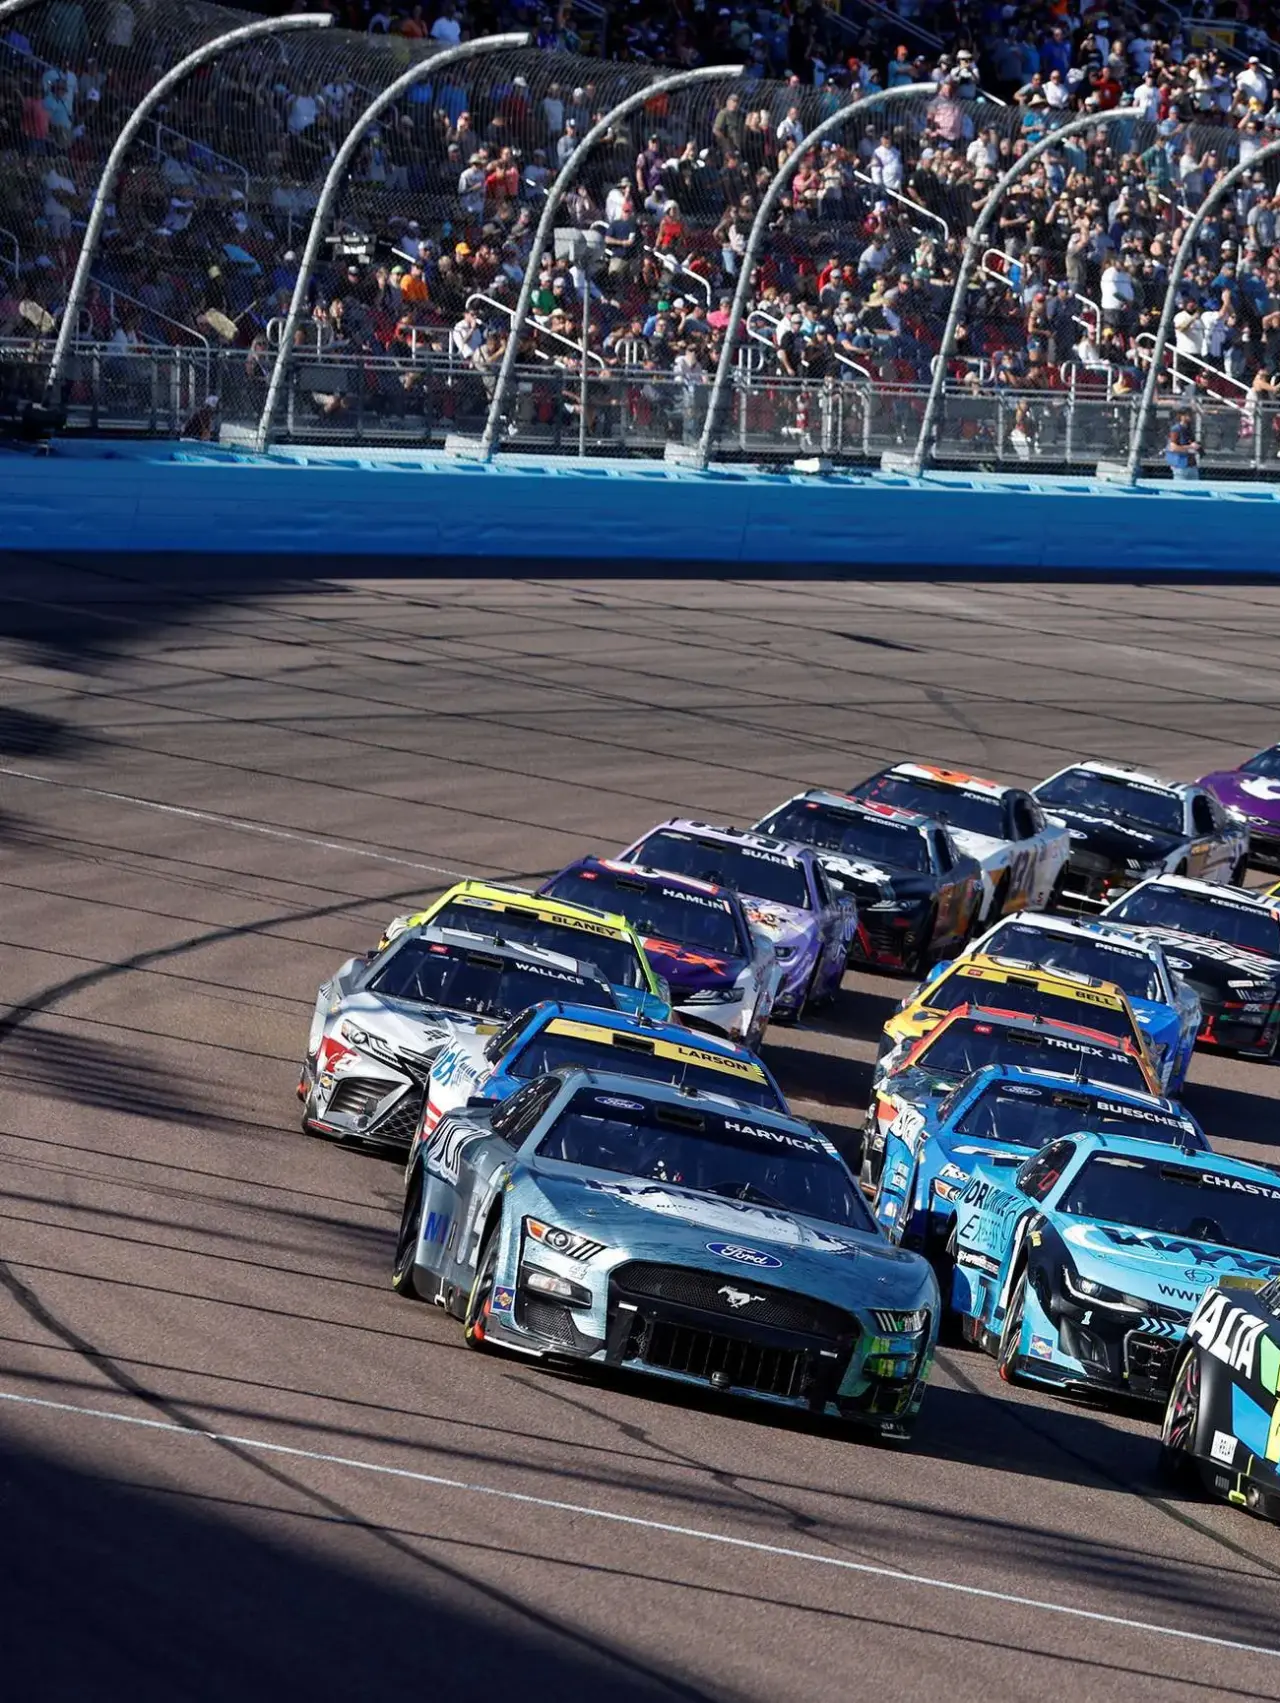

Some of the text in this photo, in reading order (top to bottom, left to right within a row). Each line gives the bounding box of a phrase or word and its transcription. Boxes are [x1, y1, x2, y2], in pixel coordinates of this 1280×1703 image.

[741, 848, 792, 867] SUÁRE
[662, 887, 725, 912] HAMLIN
[1210, 897, 1271, 918] KESELOWSK
[551, 915, 617, 937] BLANEY
[1095, 941, 1144, 960] PREECE
[515, 961, 586, 986] WALLACE
[1075, 990, 1115, 1007] BELL
[1044, 1036, 1104, 1058] TRUEX
[678, 1046, 750, 1072] LARSON
[723, 1120, 819, 1153] HARVICK
[716, 1244, 773, 1266] Ford
[1081, 1311, 1094, 1325] 1
